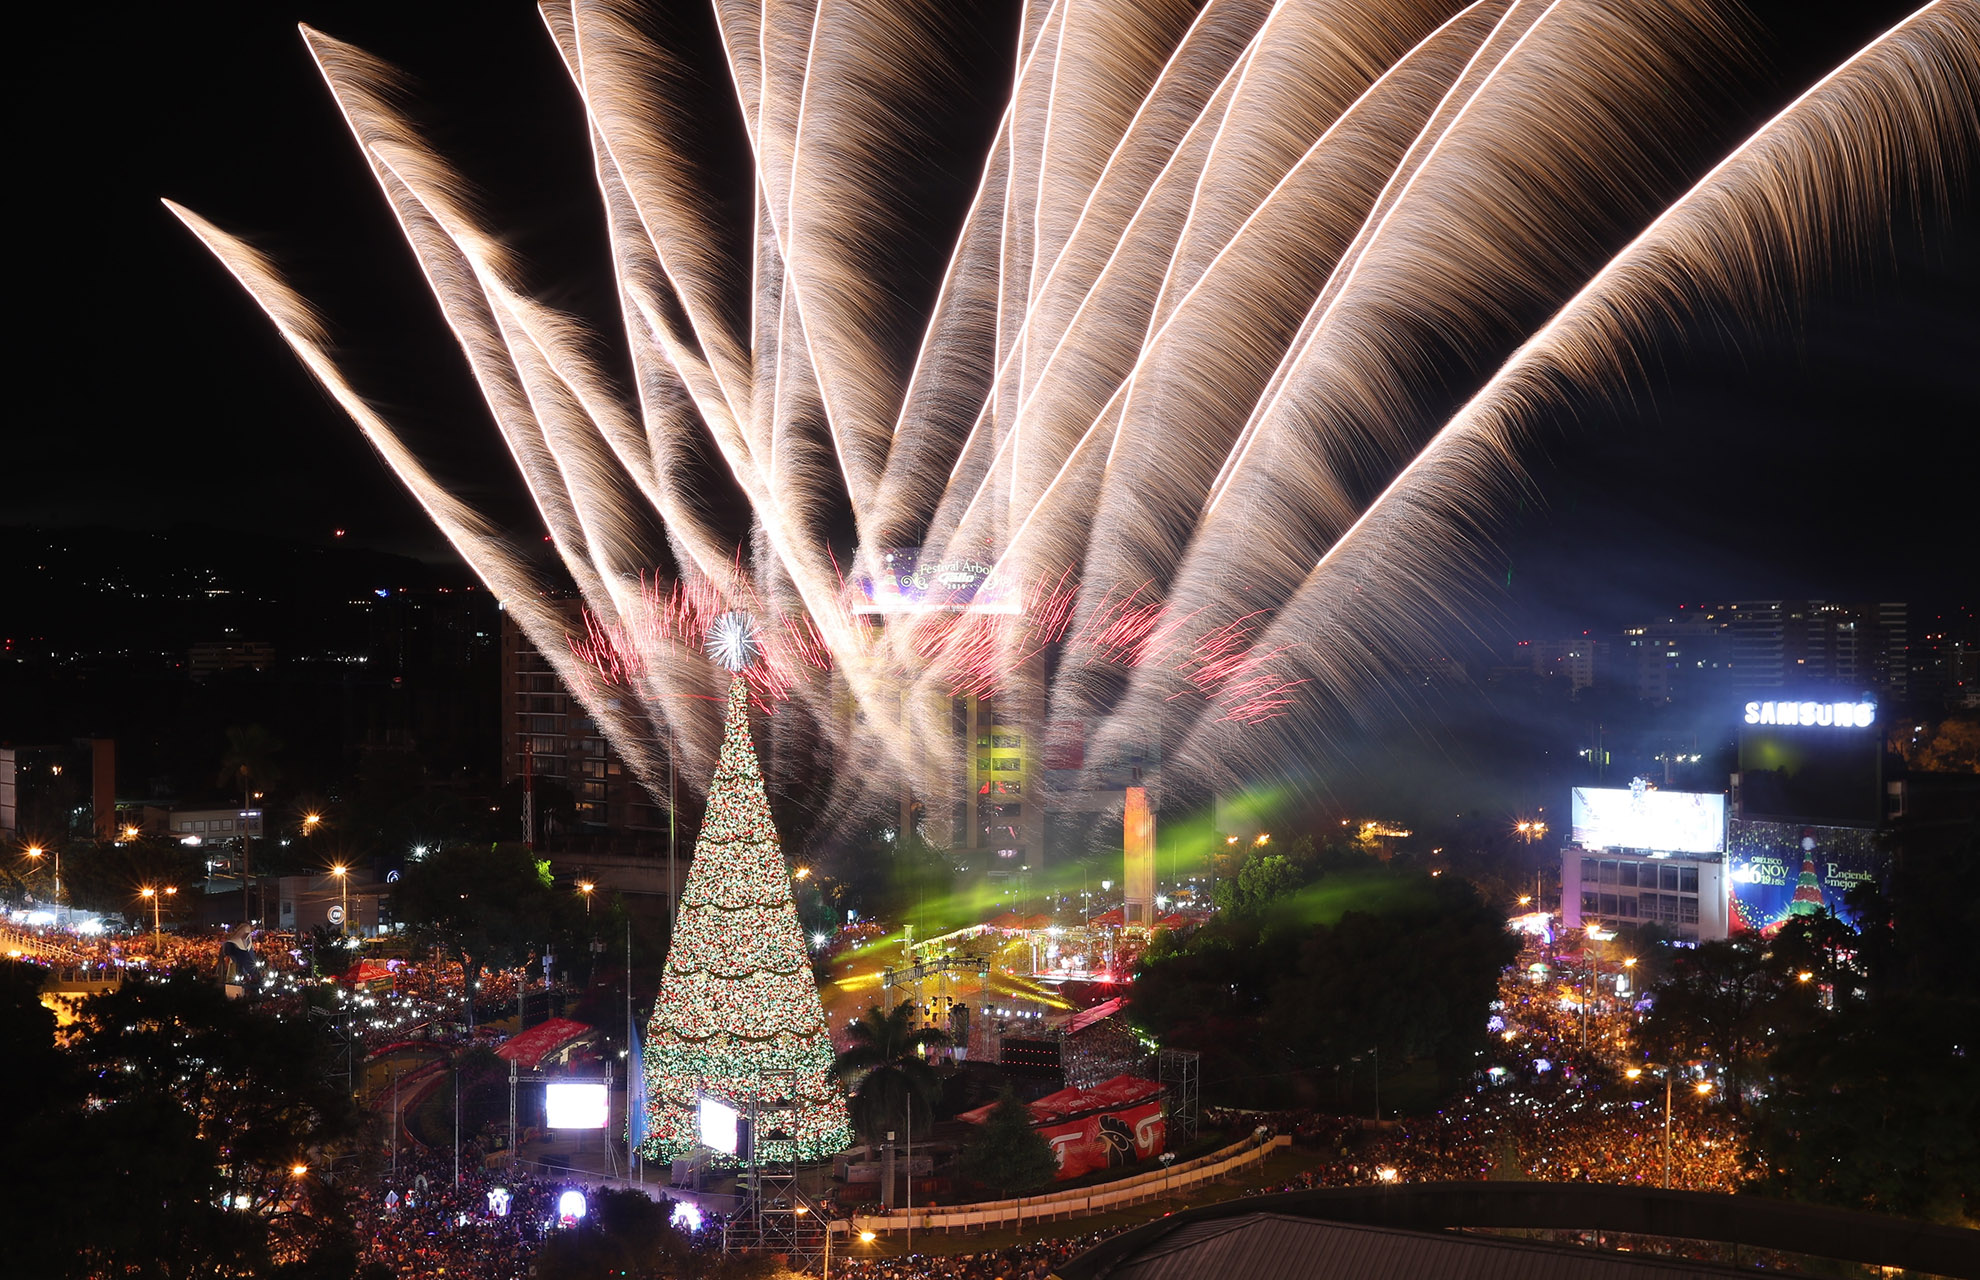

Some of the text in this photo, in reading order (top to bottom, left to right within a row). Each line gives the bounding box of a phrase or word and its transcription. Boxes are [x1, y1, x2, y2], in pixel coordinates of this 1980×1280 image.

[920, 561, 959, 575] Festival
[938, 572, 975, 585] Gallo
[1744, 702, 1875, 727] SAMSUNG
[1751, 856, 1783, 866] OBELISCO
[1740, 862, 1789, 884] 16 NOV
[1826, 862, 1872, 881] Enciende
[1772, 878, 1785, 886] HRS
[1830, 878, 1858, 891] mejor
